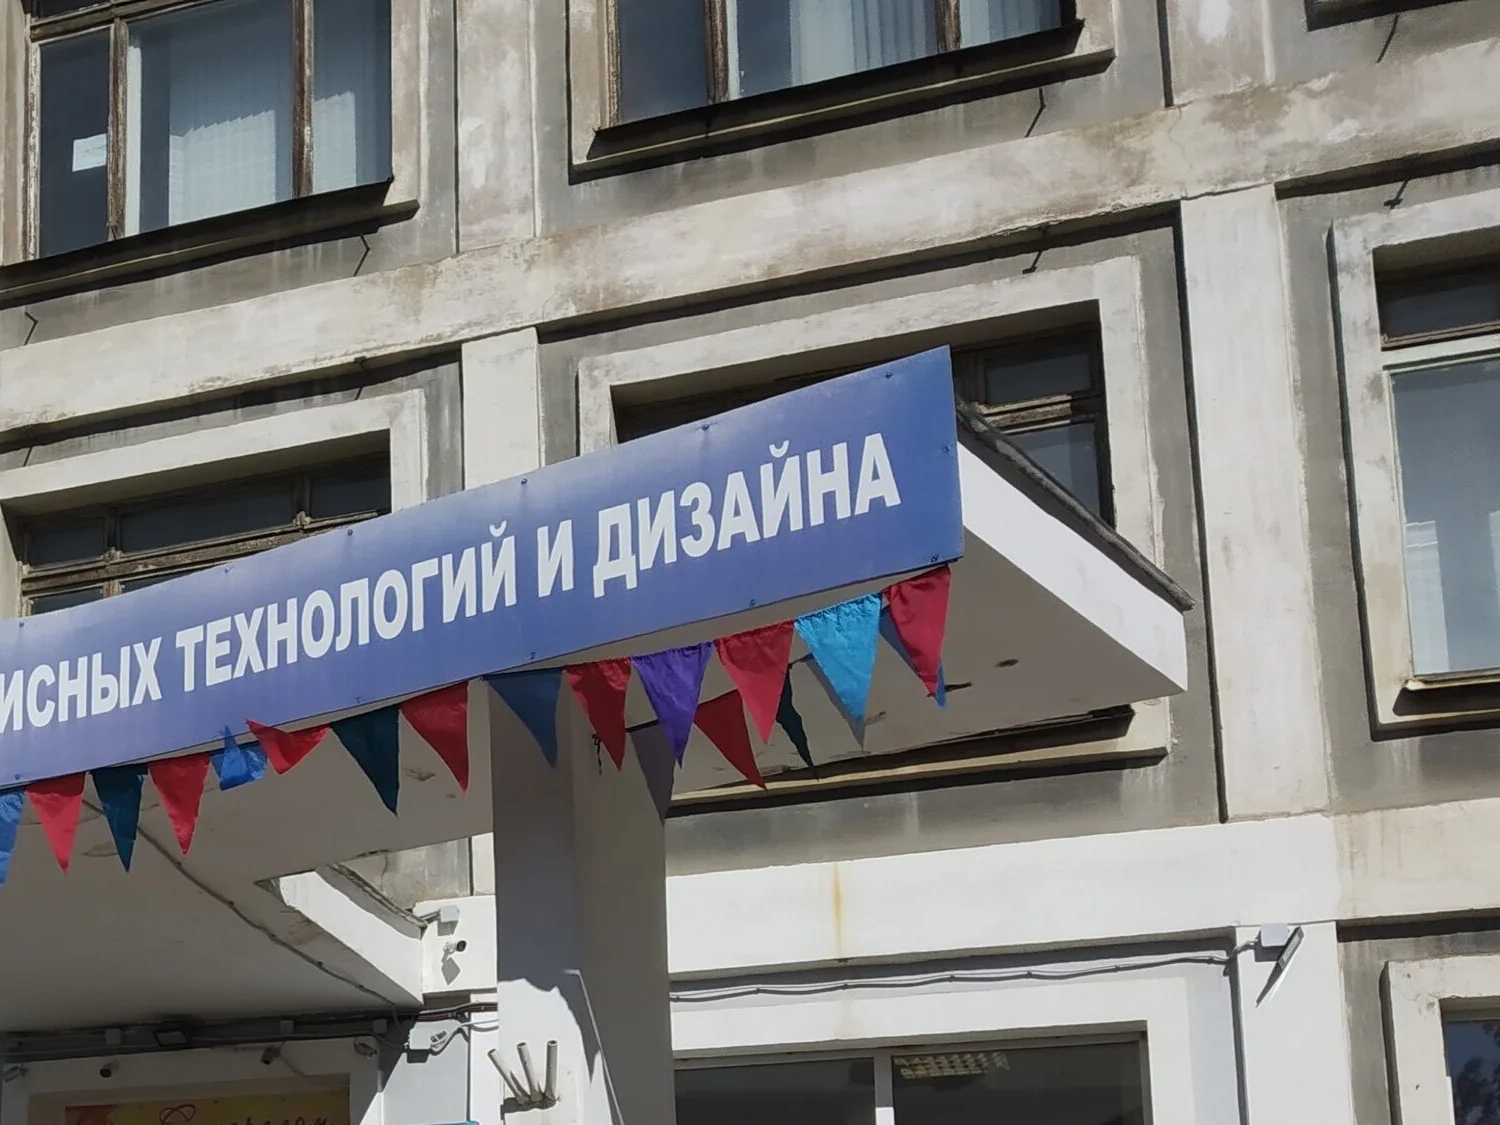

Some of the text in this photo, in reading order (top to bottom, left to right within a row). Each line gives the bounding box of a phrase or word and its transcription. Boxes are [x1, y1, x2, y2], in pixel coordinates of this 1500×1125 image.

[175, 523, 516, 692] ТЕХНОЛОГИЙ
[537, 519, 574, 598] И
[593, 433, 902, 599] ДИЗАЙНА
